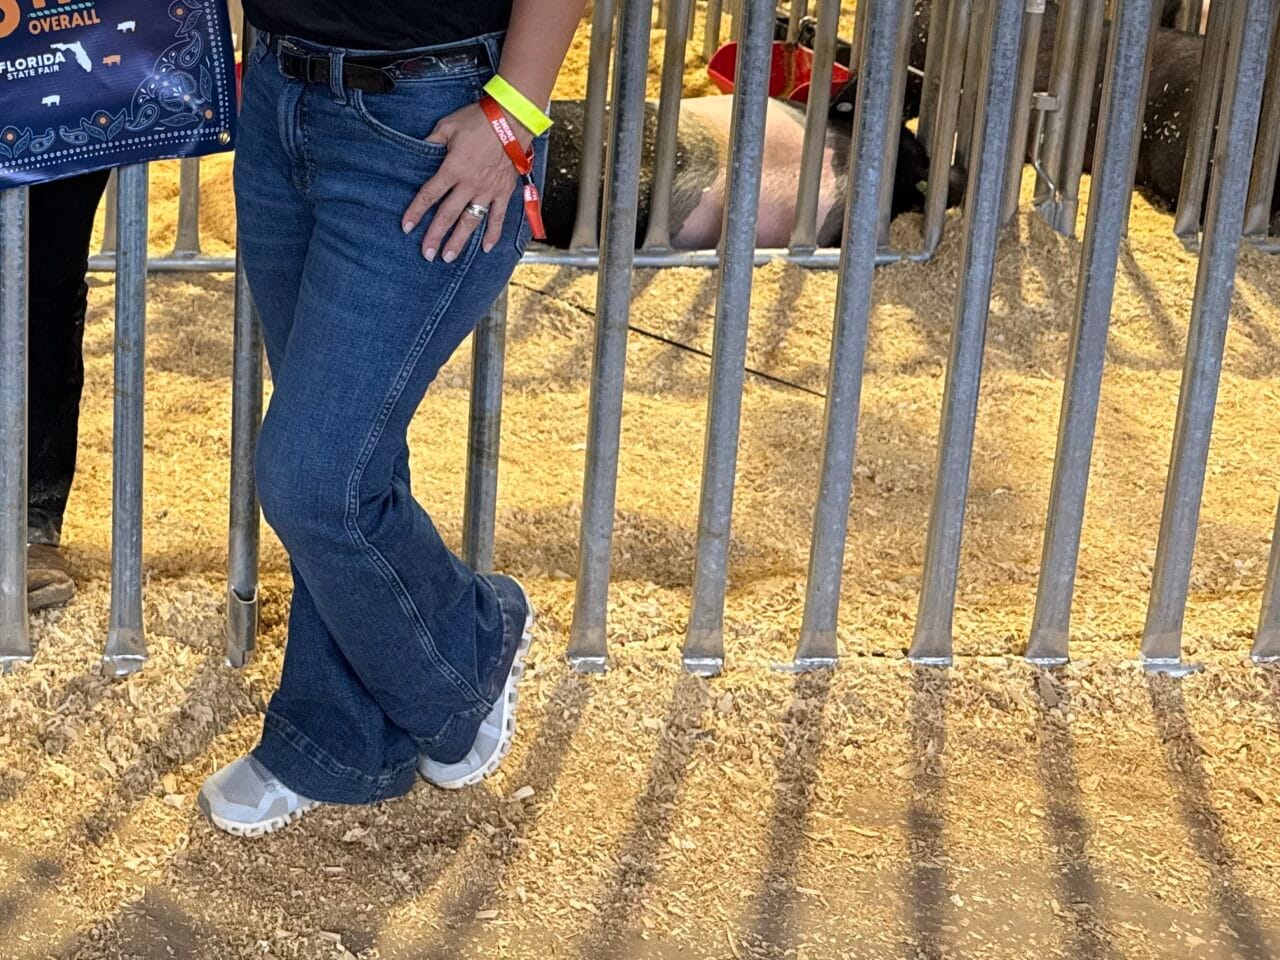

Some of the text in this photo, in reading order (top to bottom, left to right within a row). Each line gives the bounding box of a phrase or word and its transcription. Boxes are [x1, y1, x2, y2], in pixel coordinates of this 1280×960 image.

[28, 8, 100, 35] OVERALL
[6, 64, 60, 80] STATE FAIR
[491, 120, 509, 146] YOUTH
